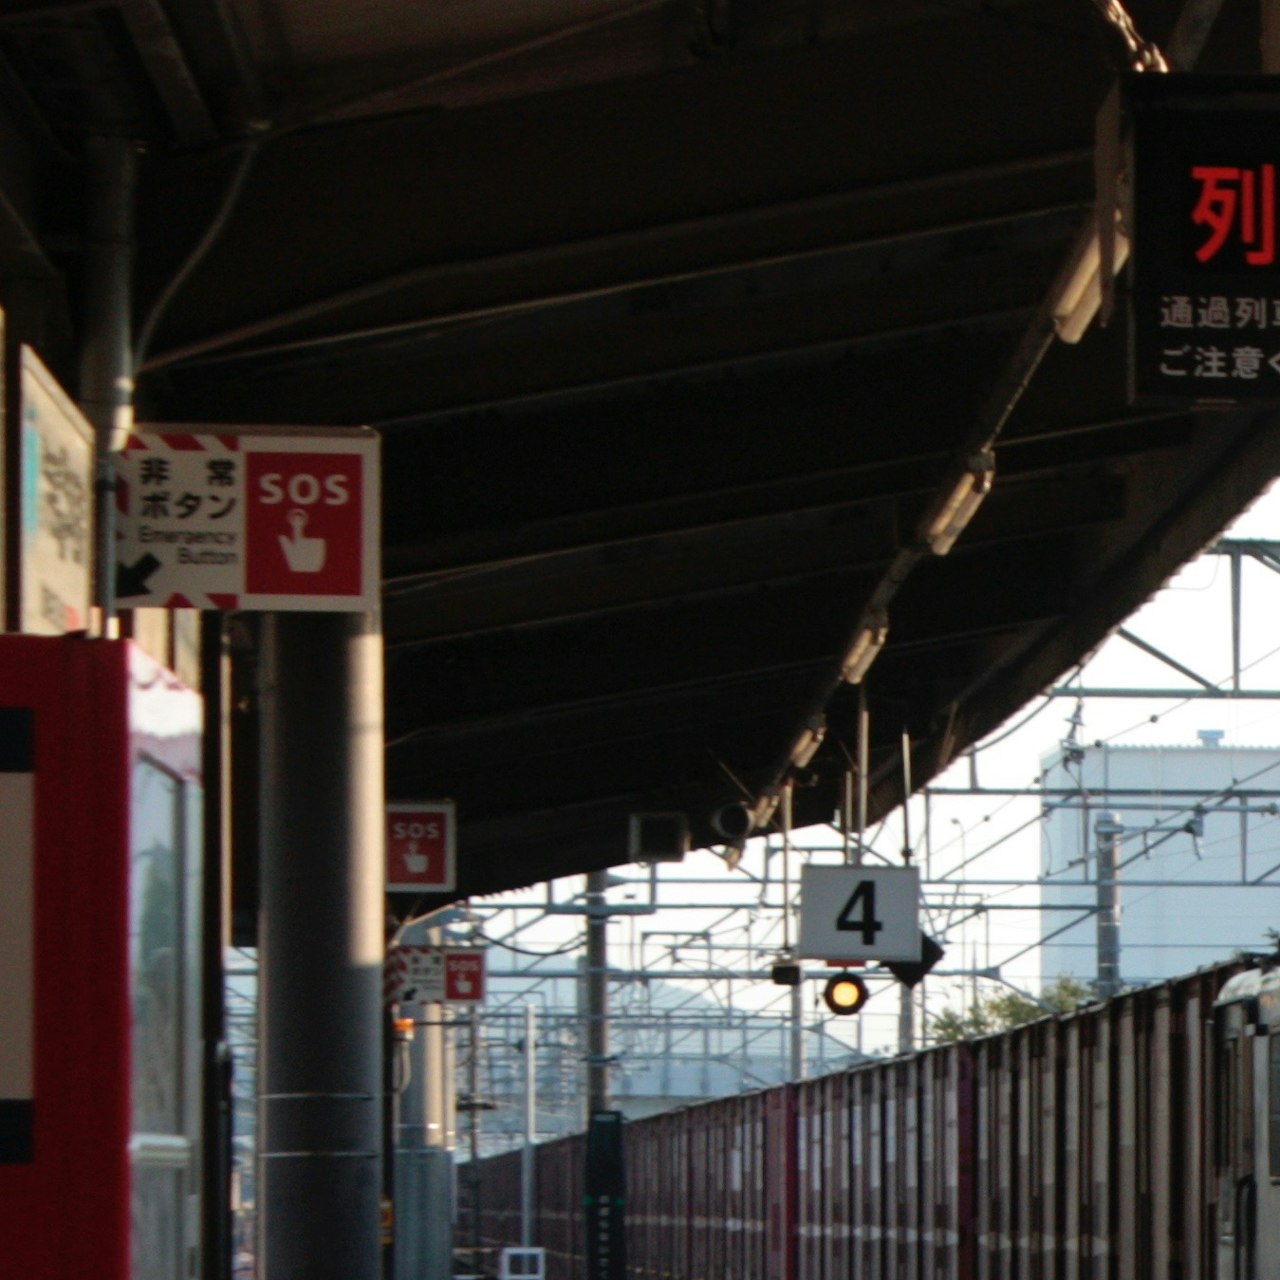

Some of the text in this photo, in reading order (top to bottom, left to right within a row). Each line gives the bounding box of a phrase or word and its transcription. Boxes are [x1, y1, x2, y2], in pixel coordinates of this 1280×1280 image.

[140, 457, 236, 488] 非常
[259, 473, 349, 506] SOS
[140, 492, 236, 520] ボタン
[139, 525, 235, 546] Emergency
[178, 548, 236, 566] Button
[393, 822, 439, 840] SOS
[836, 880, 883, 945] 4
